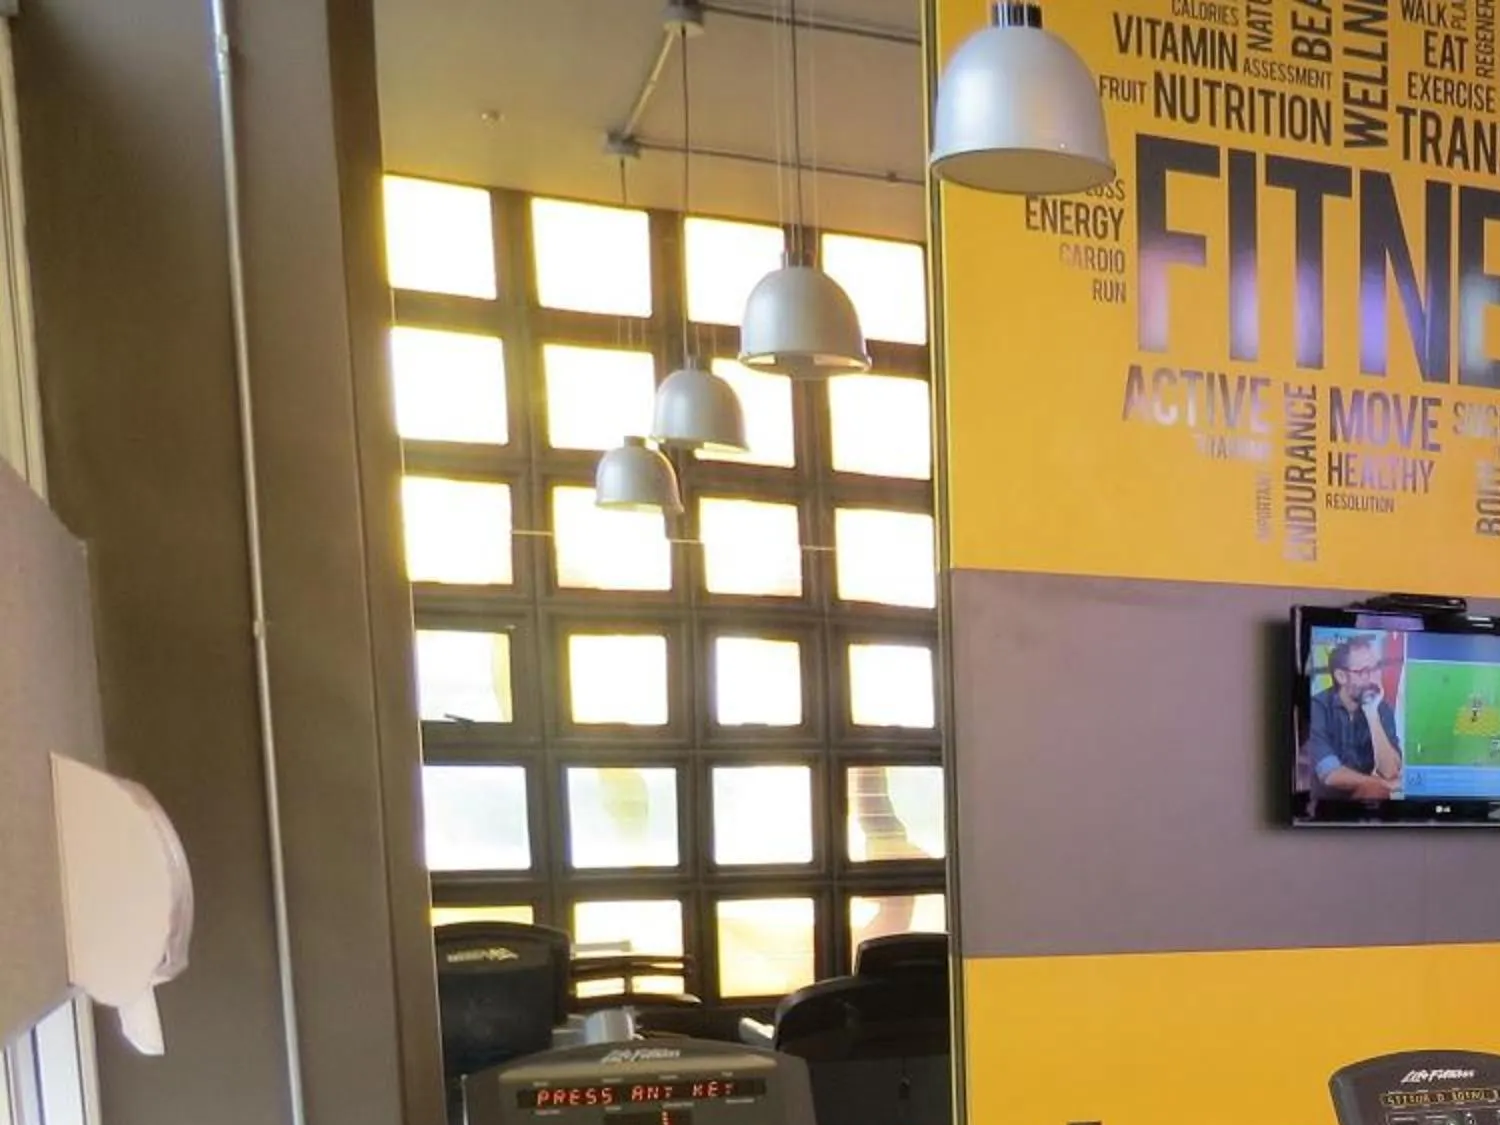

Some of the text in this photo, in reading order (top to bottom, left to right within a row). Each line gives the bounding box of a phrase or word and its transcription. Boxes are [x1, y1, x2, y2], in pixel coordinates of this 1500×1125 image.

[1171, 0, 1239, 27] CALORIES
[1400, 0, 1448, 29] WALK
[1113, 11, 1238, 74] VITAMIN
[1423, 29, 1469, 74] EAT
[1100, 74, 1147, 105] FRUIT
[1243, 58, 1333, 91] ASSESSMENT
[1343, 0, 1389, 148] WELLN
[1407, 71, 1497, 114] EXERCISE
[1153, 70, 1333, 148] NUTRITION
[1025, 193, 1125, 242] ENERGY
[1060, 241, 1126, 275] CARDIO
[1092, 278, 1127, 304] RUN
[1121, 364, 1272, 434] ACTIVE
[1328, 386, 1443, 452] MOVE
[1283, 381, 1318, 563] ENDURANCE
[1327, 451, 1435, 495] HEALTHY
[1325, 492, 1395, 513] RESOLUTION
[536, 1087, 613, 1106] PRESS
